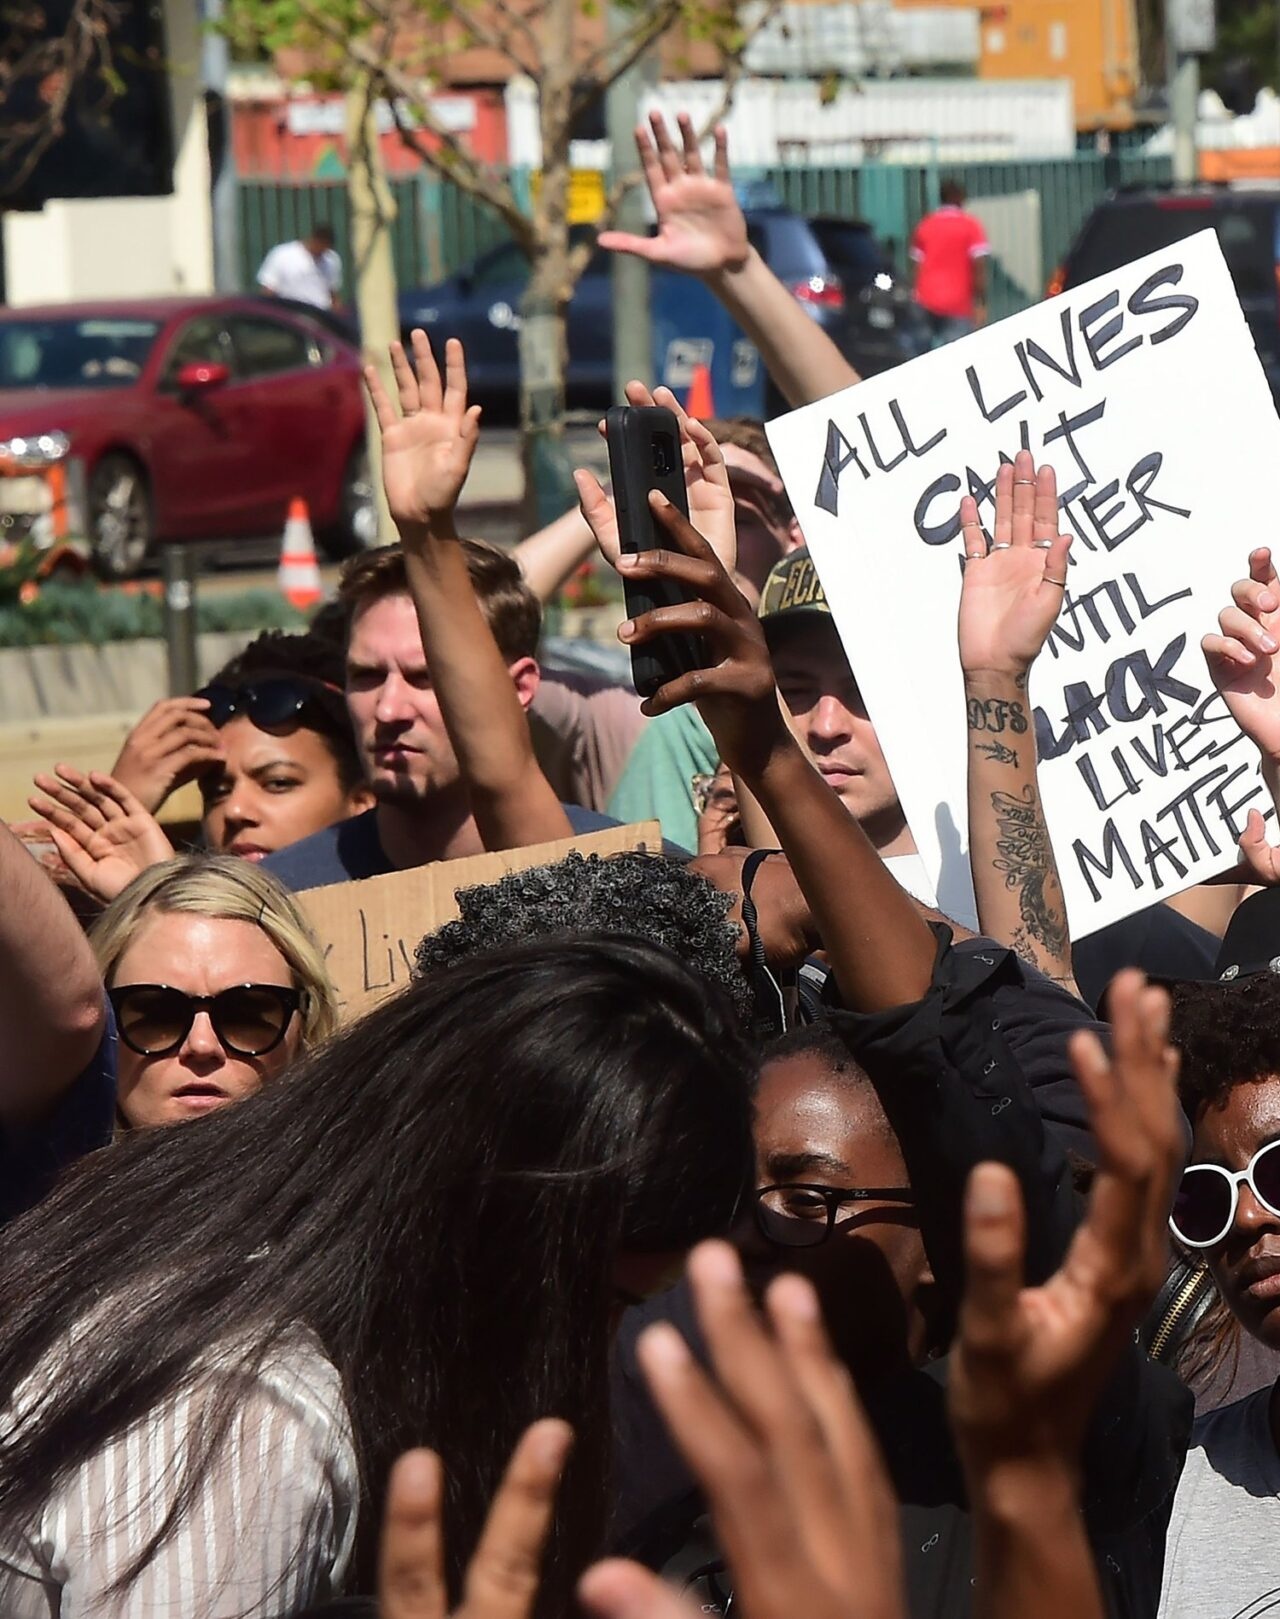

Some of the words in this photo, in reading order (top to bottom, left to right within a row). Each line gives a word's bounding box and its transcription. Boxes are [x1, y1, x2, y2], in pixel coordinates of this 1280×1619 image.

[814, 398, 948, 517] ALL
[965, 263, 1200, 423] LIVES
[1045, 572, 1194, 661] NTIL
[1033, 632, 1202, 764] LACK
[1072, 757, 1275, 903] MATTE
